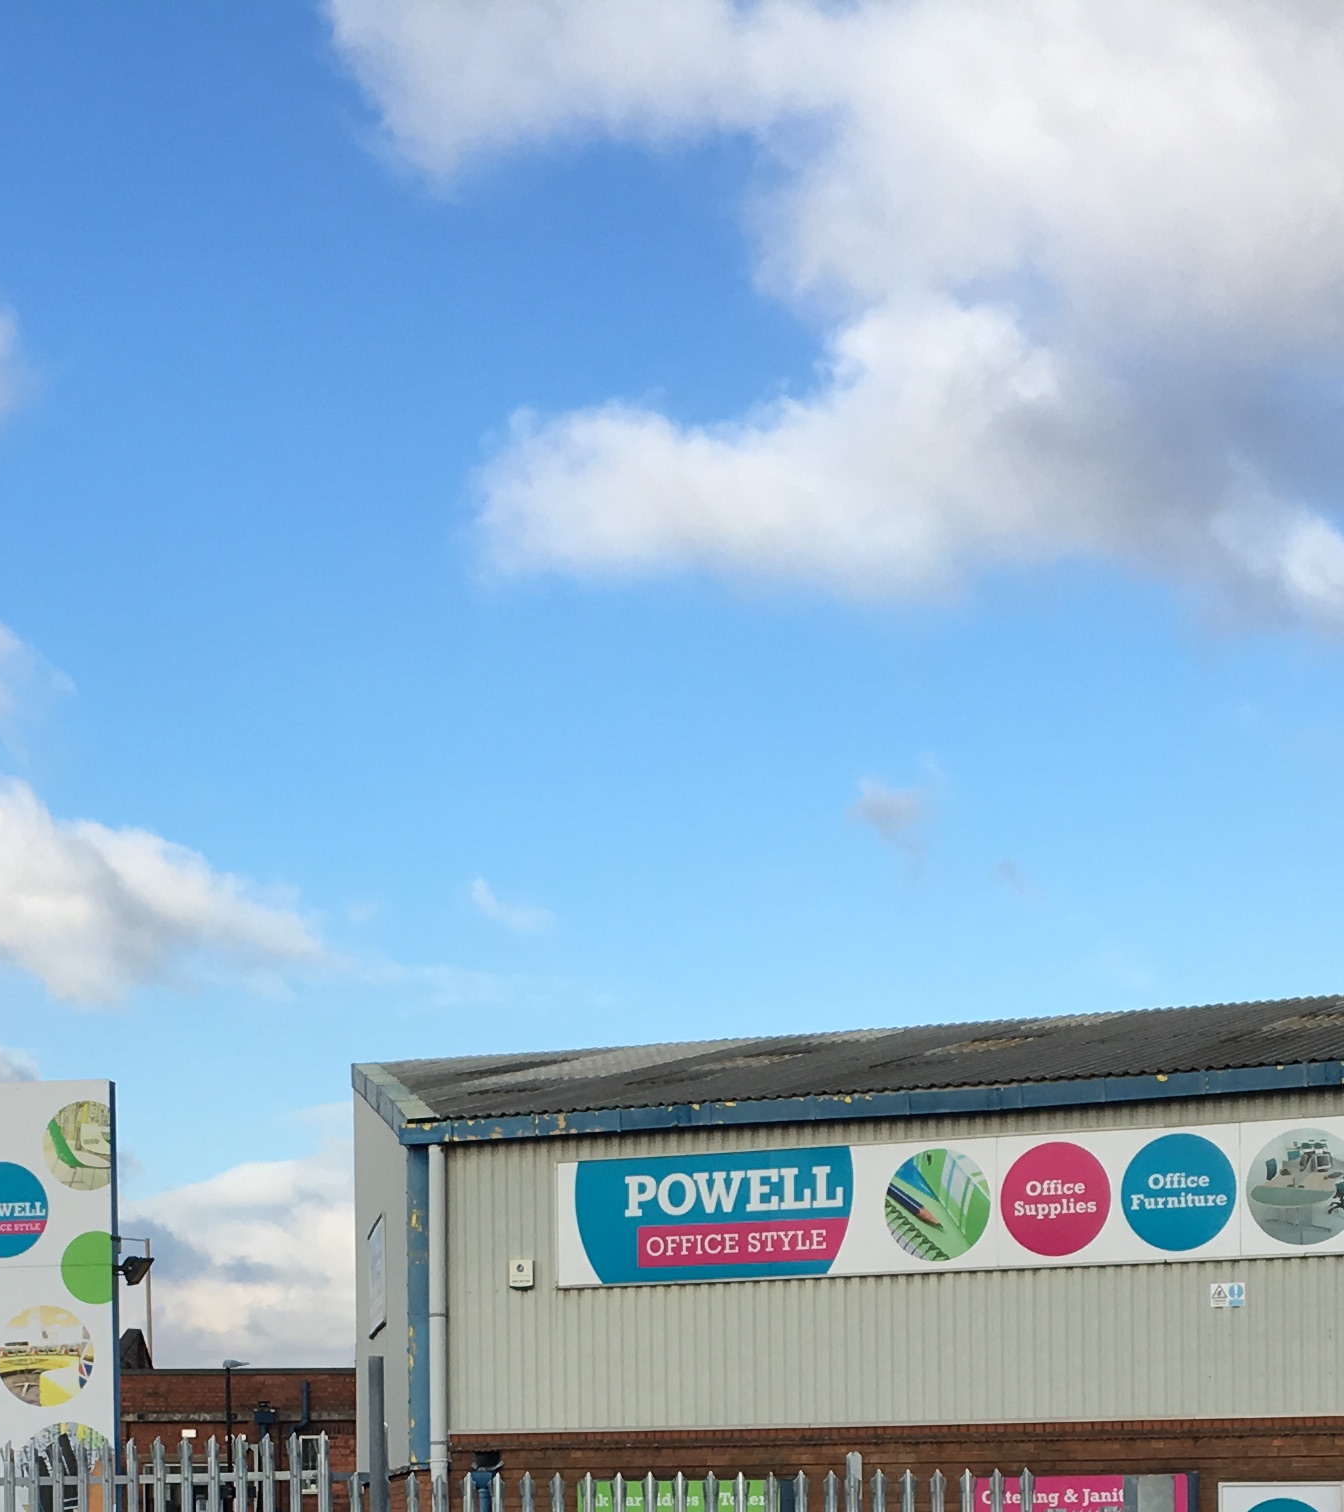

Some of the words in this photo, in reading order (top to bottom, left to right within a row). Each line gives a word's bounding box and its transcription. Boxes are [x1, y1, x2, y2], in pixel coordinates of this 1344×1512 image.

[1025, 1179, 1086, 1197] Office
[1148, 1172, 1210, 1190] Office
[624, 1165, 844, 1217] POWELL
[1014, 1198, 1097, 1219] Supplies
[1130, 1192, 1228, 1210] Furniture
[13, 1222, 41, 1232] STYLE
[646, 1233, 739, 1257] OFFICE
[747, 1229, 827, 1252] STYLE
[982, 1488, 1059, 1507] Cteing
[1063, 1488, 1079, 1503] &
